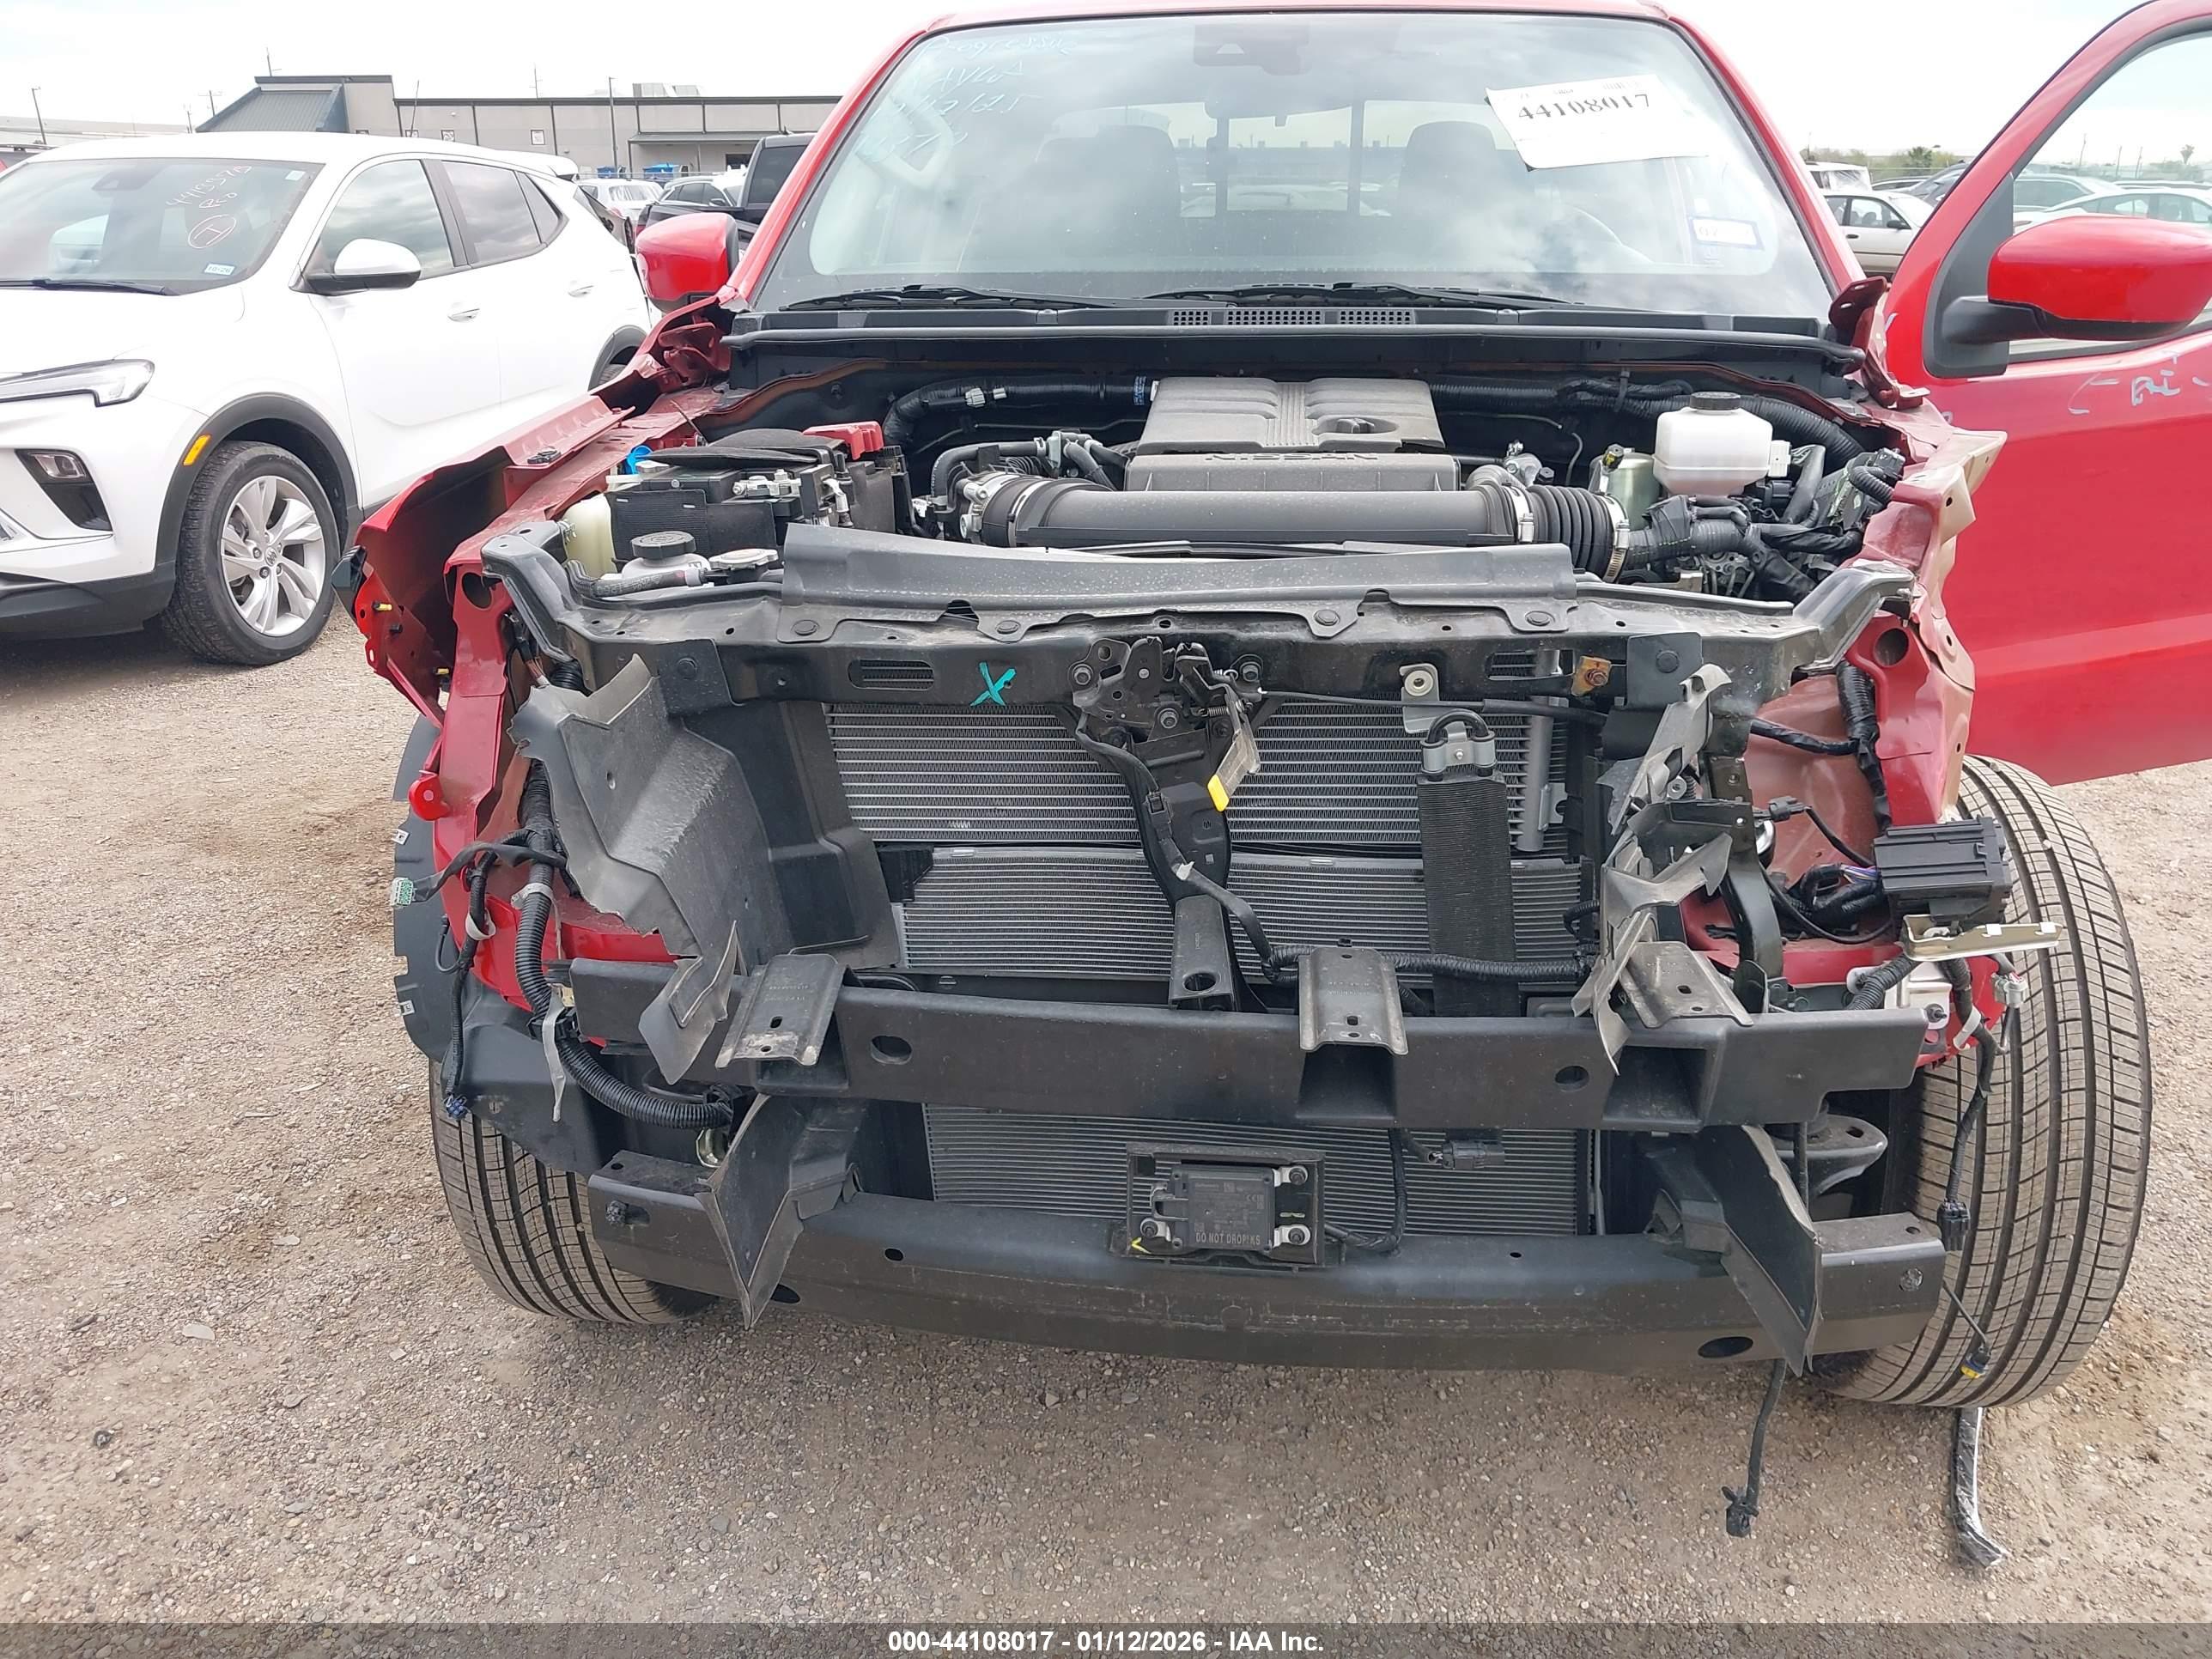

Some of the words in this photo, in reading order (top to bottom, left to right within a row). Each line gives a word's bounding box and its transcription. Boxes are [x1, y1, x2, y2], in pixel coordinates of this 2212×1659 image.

[1518, 93, 1650, 119] 44108017
[1195, 1231, 1207, 1243] DO
[1208, 1231, 1224, 1244] NOT
